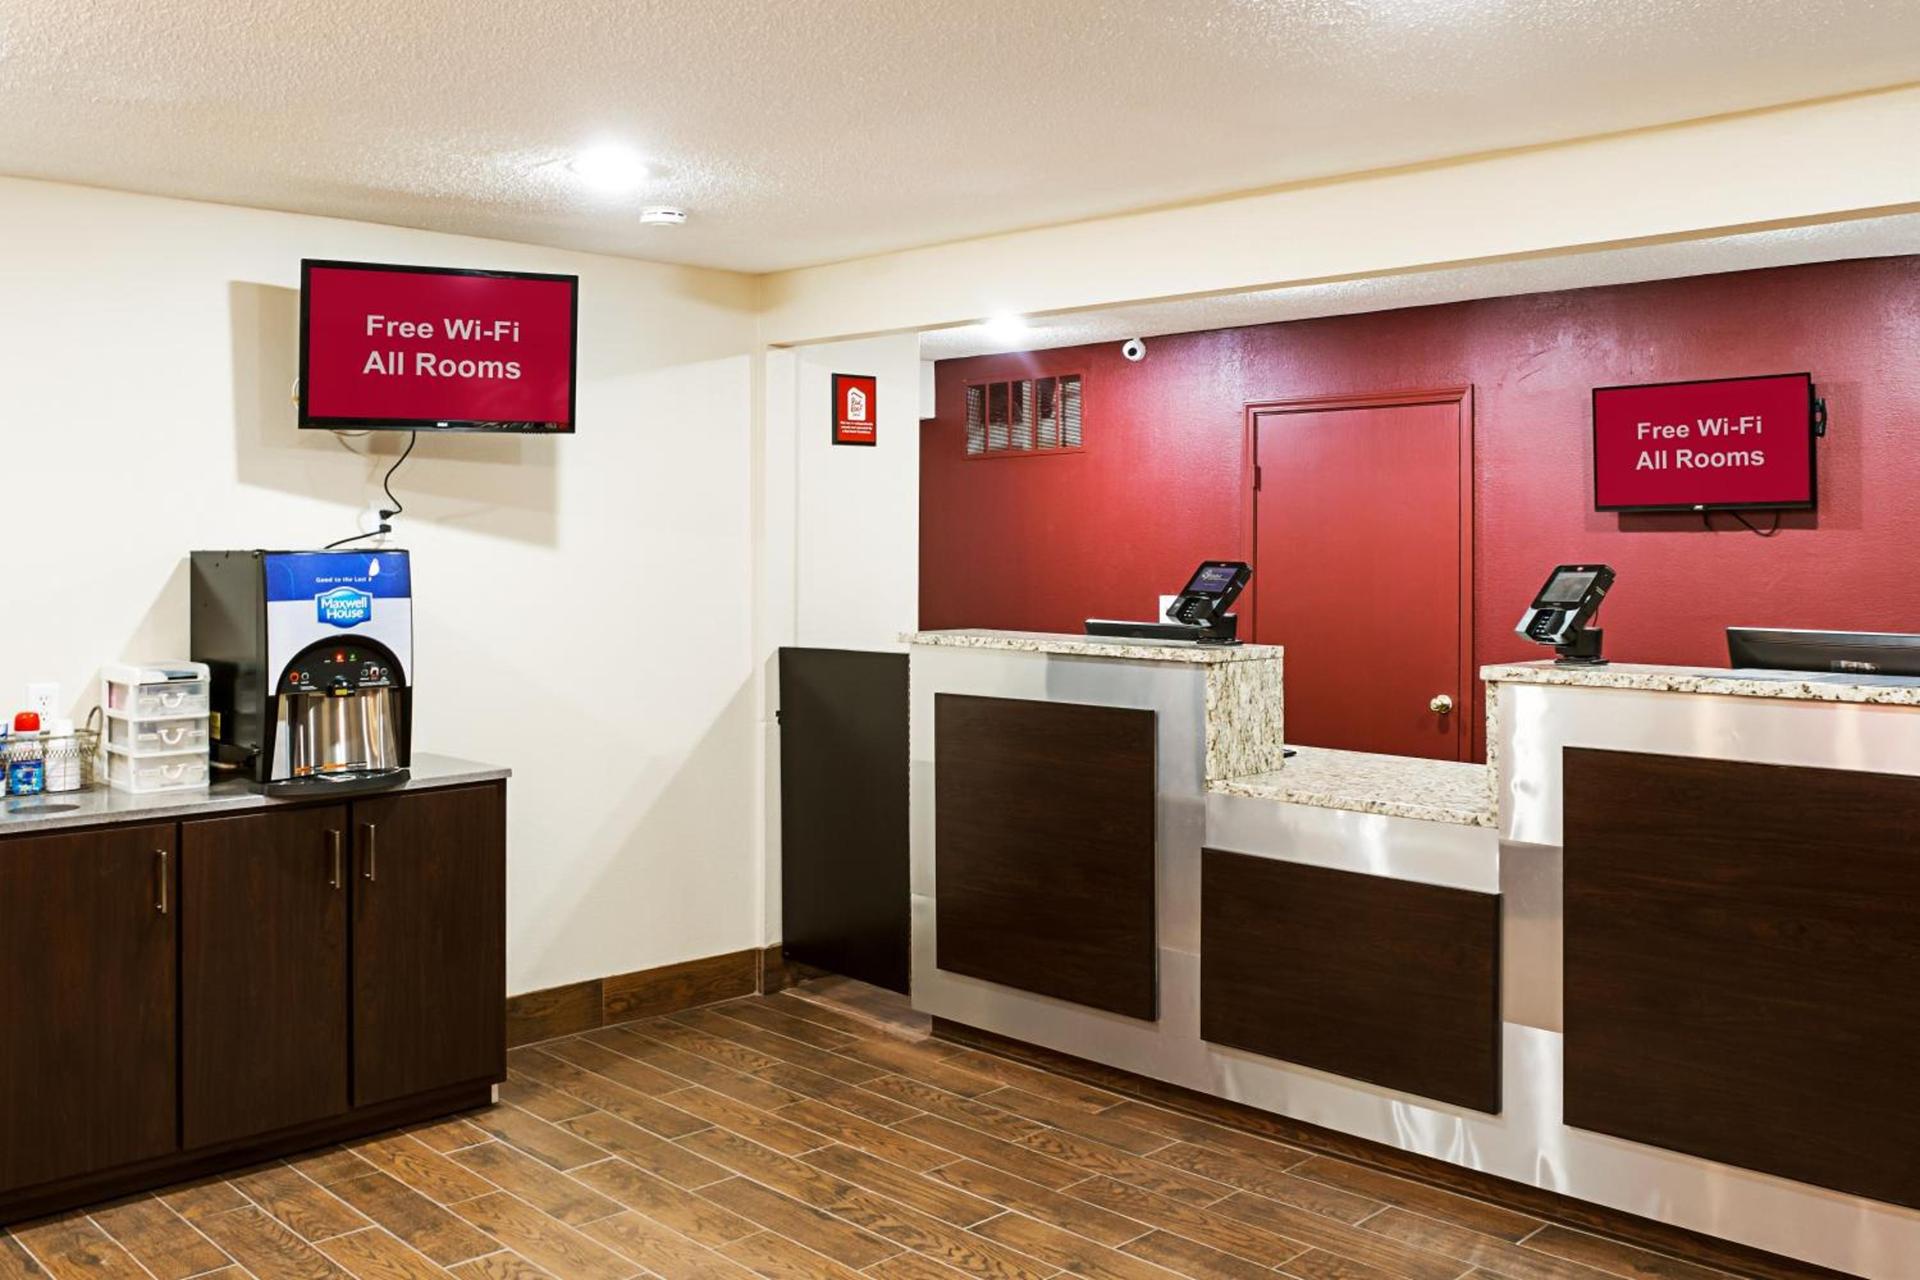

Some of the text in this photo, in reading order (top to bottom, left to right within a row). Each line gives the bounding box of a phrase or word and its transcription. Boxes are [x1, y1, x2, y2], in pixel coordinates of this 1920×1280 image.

[366, 315, 520, 342] Free Wi-Fi
[362, 350, 522, 380] All Rooms
[1637, 415, 1762, 440] Free Wi-Fi
[1635, 448, 1765, 471] All Rooms
[320, 596, 367, 609] Maxwell
[326, 609, 364, 619] House
